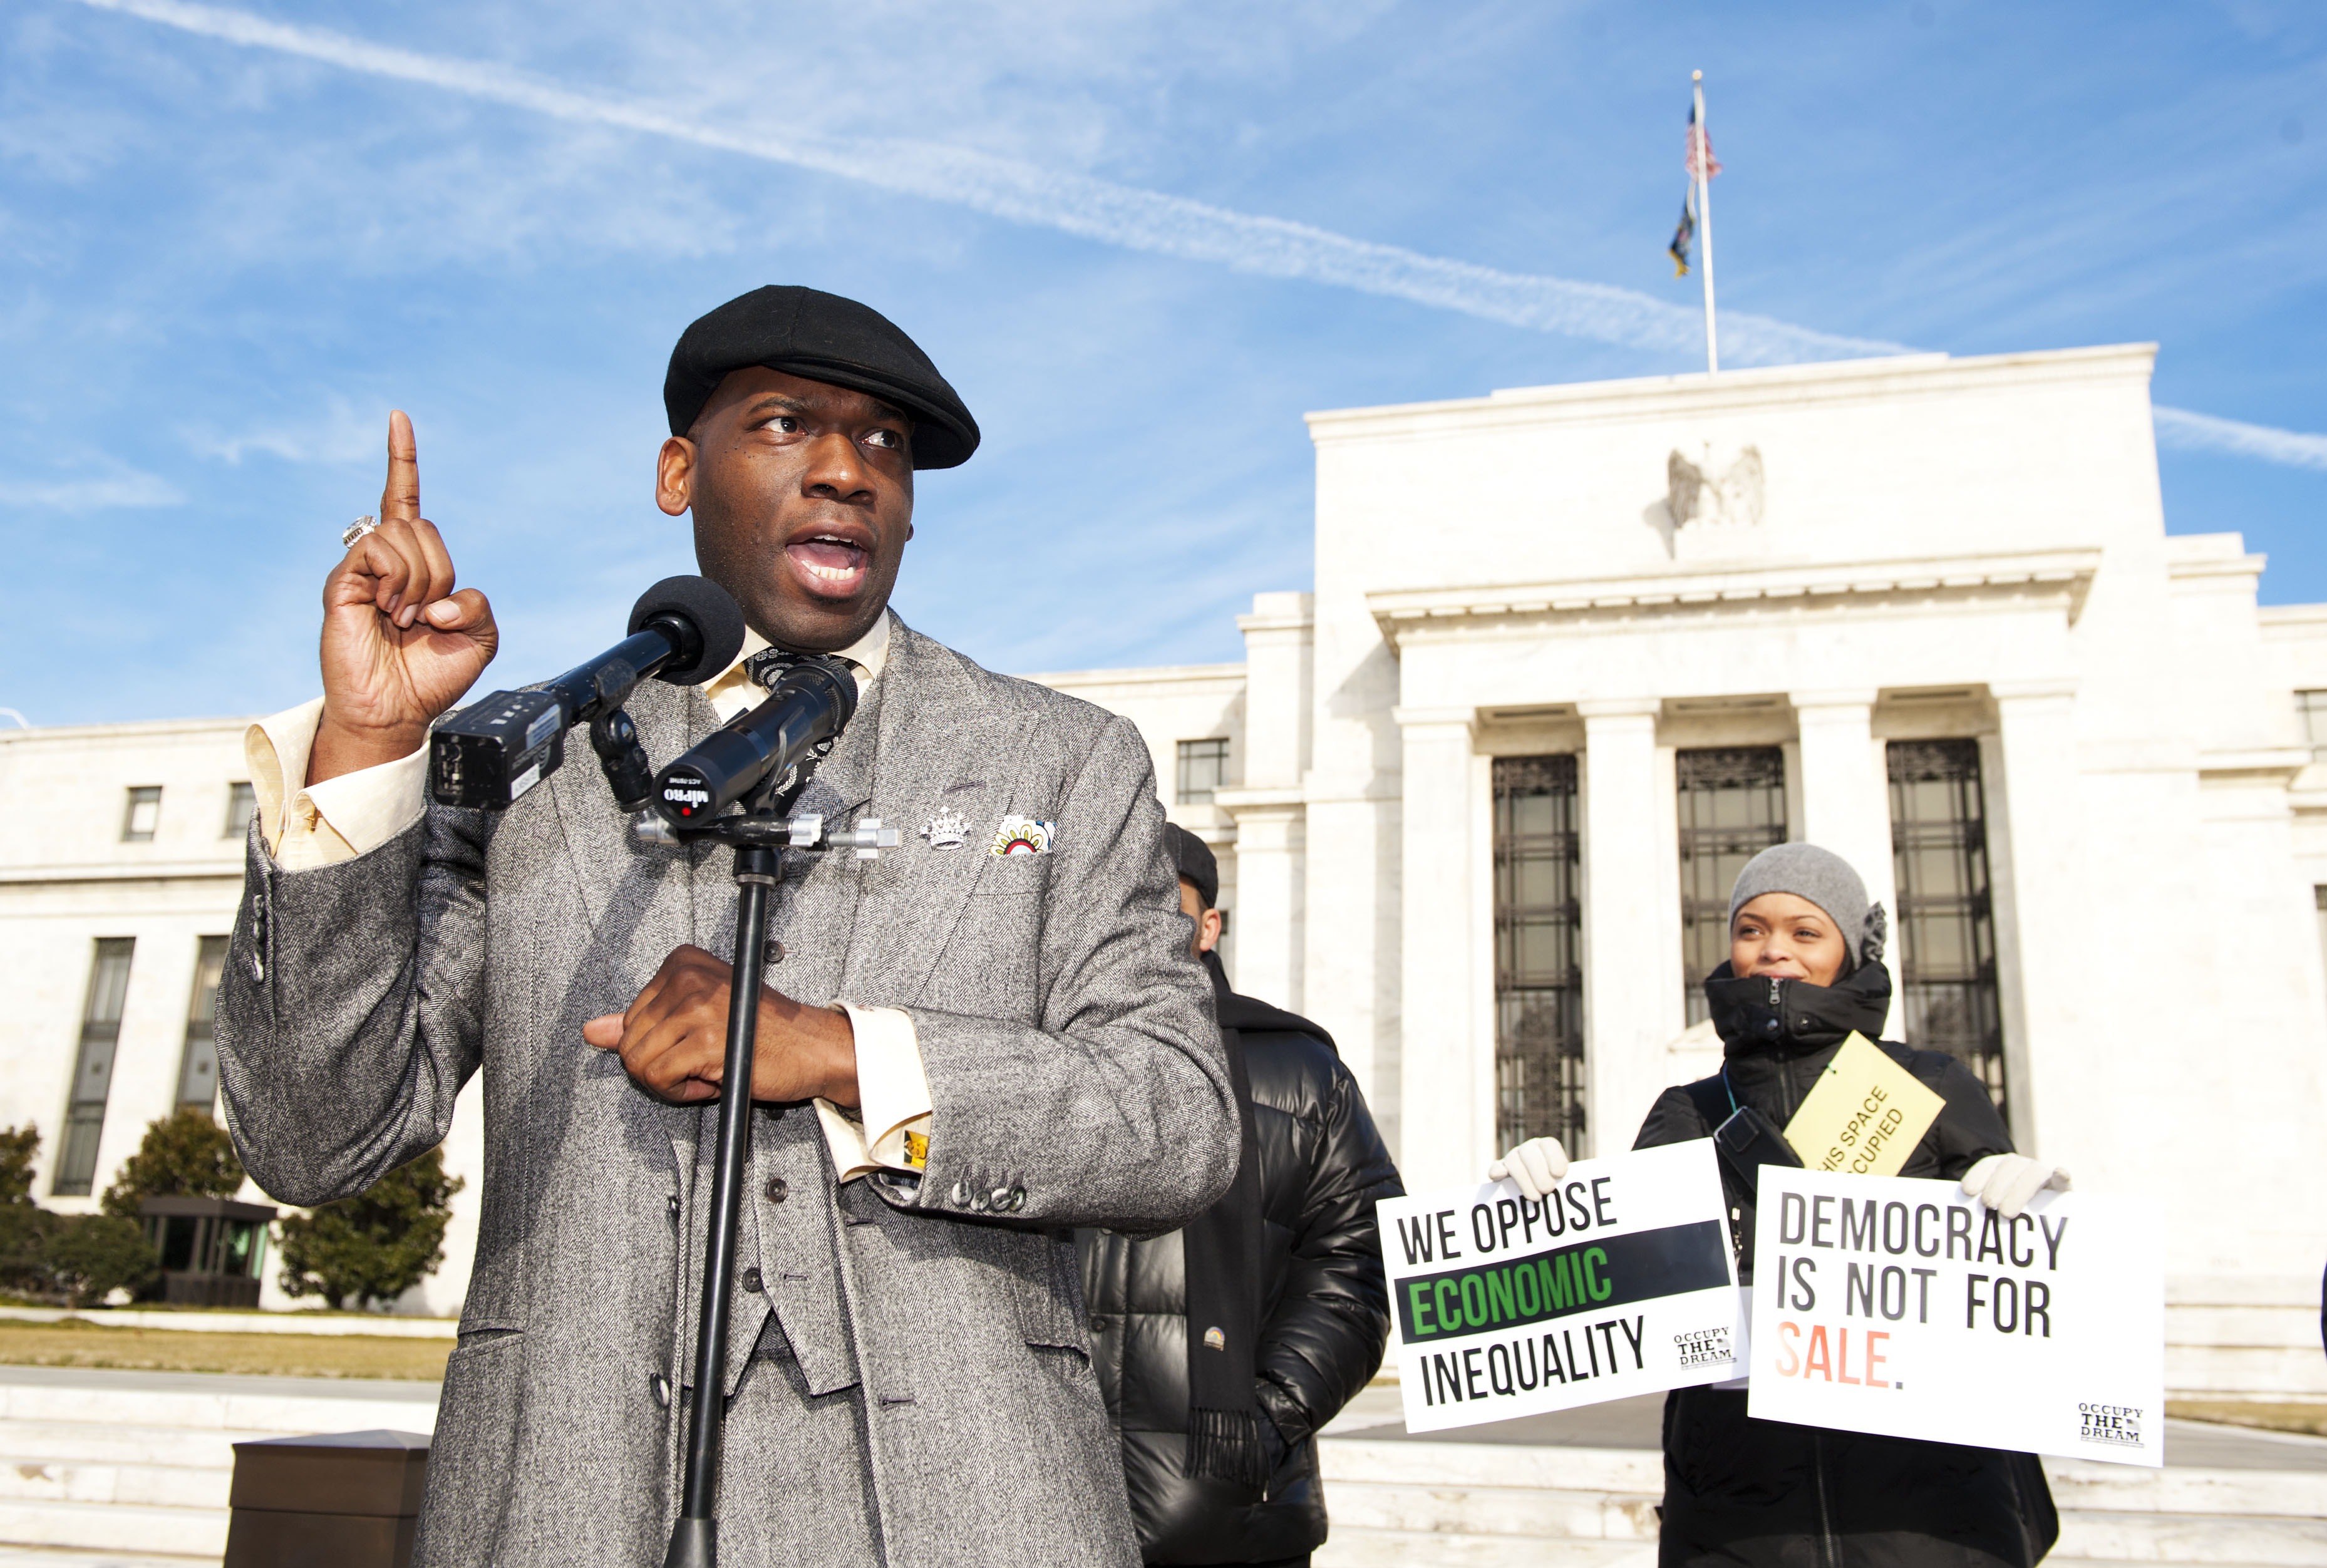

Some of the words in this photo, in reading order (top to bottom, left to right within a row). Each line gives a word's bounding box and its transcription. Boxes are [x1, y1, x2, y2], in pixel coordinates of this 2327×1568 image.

[1818, 1147, 1845, 1171] HIS
[1840, 1085, 1889, 1147] SPACE
[1847, 1108, 1904, 1175] CUPIED
[1397, 1209, 1462, 1266] WE
[1471, 1176, 1618, 1254] OPPOSE
[1779, 1191, 2069, 1271] DEMOCRACY
[1408, 1246, 1613, 1336] ECONOMIC
[1777, 1254, 1817, 1312] IS
[1845, 1261, 1937, 1324] NOT
[1966, 1272, 2051, 1338] FOR
[1420, 1314, 1644, 1406] INEQUALITY
[1674, 1326, 1729, 1343] OCCUPY
[1678, 1339, 1715, 1355] THE
[1679, 1349, 1731, 1365] DREAM
[1775, 1321, 1904, 1390] SALE.
[2078, 1402, 2143, 1418] OCCUPY
[2081, 1413, 2123, 1429] THE
[2081, 1426, 2140, 1442] DREAM
